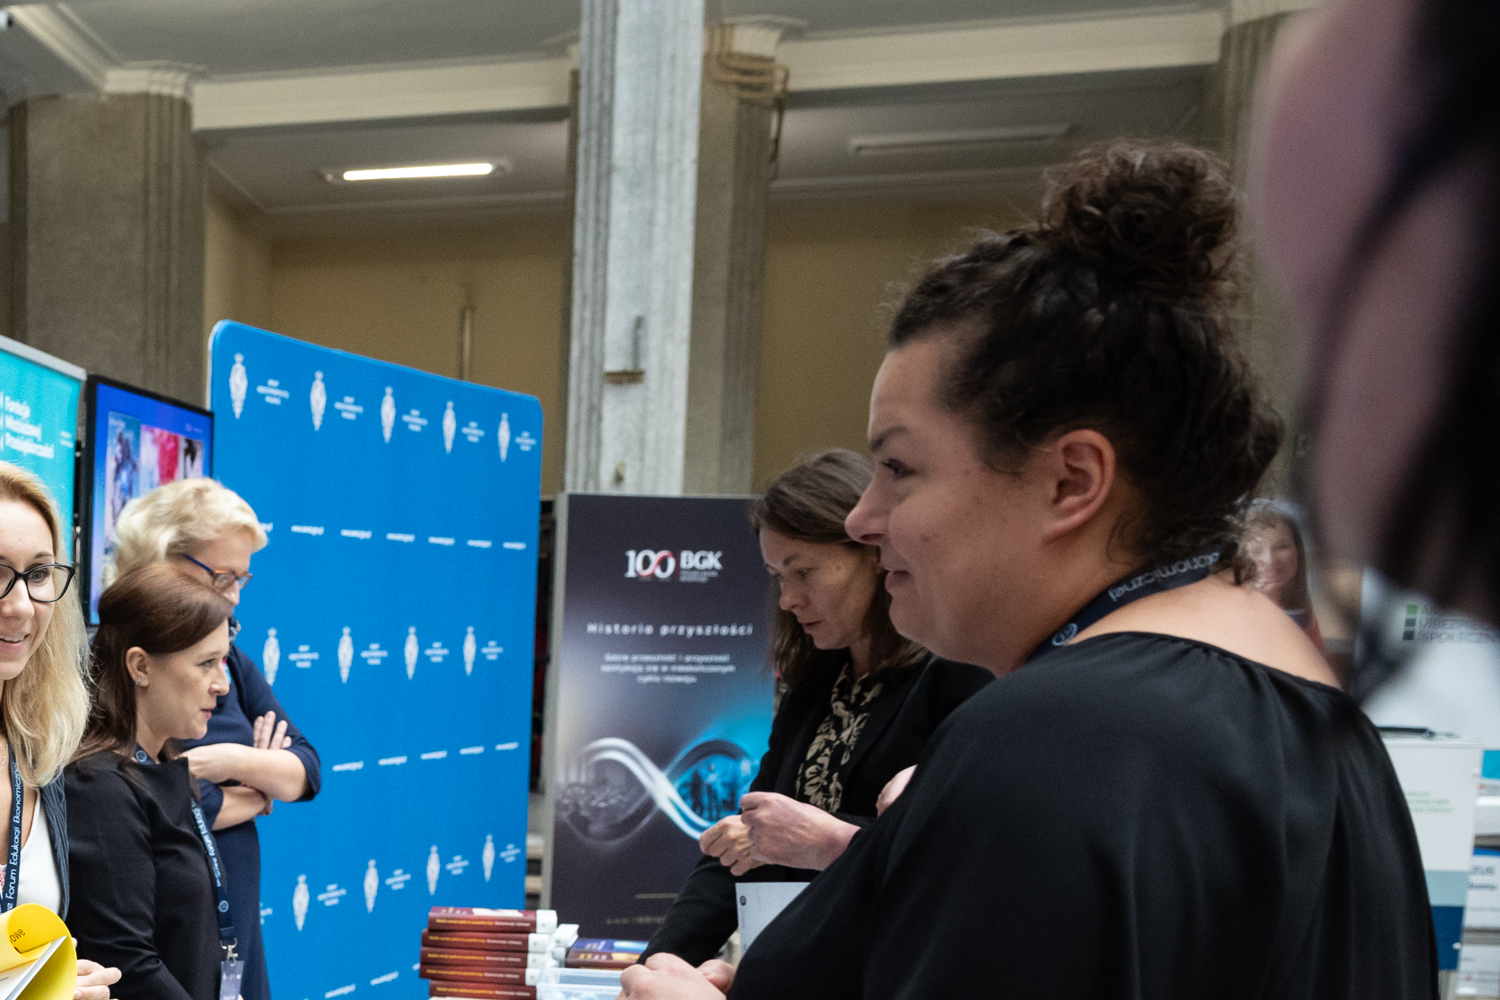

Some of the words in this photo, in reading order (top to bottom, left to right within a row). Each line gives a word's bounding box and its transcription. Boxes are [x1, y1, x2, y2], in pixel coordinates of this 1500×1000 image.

[624, 549, 676, 578] 100
[680, 551, 723, 570] BGK
[1107, 552, 1220, 602] konomicznej
[586, 622, 654, 635] Historia
[9, 826, 21, 865] Edukacji
[6, 868, 17, 900] Forum
